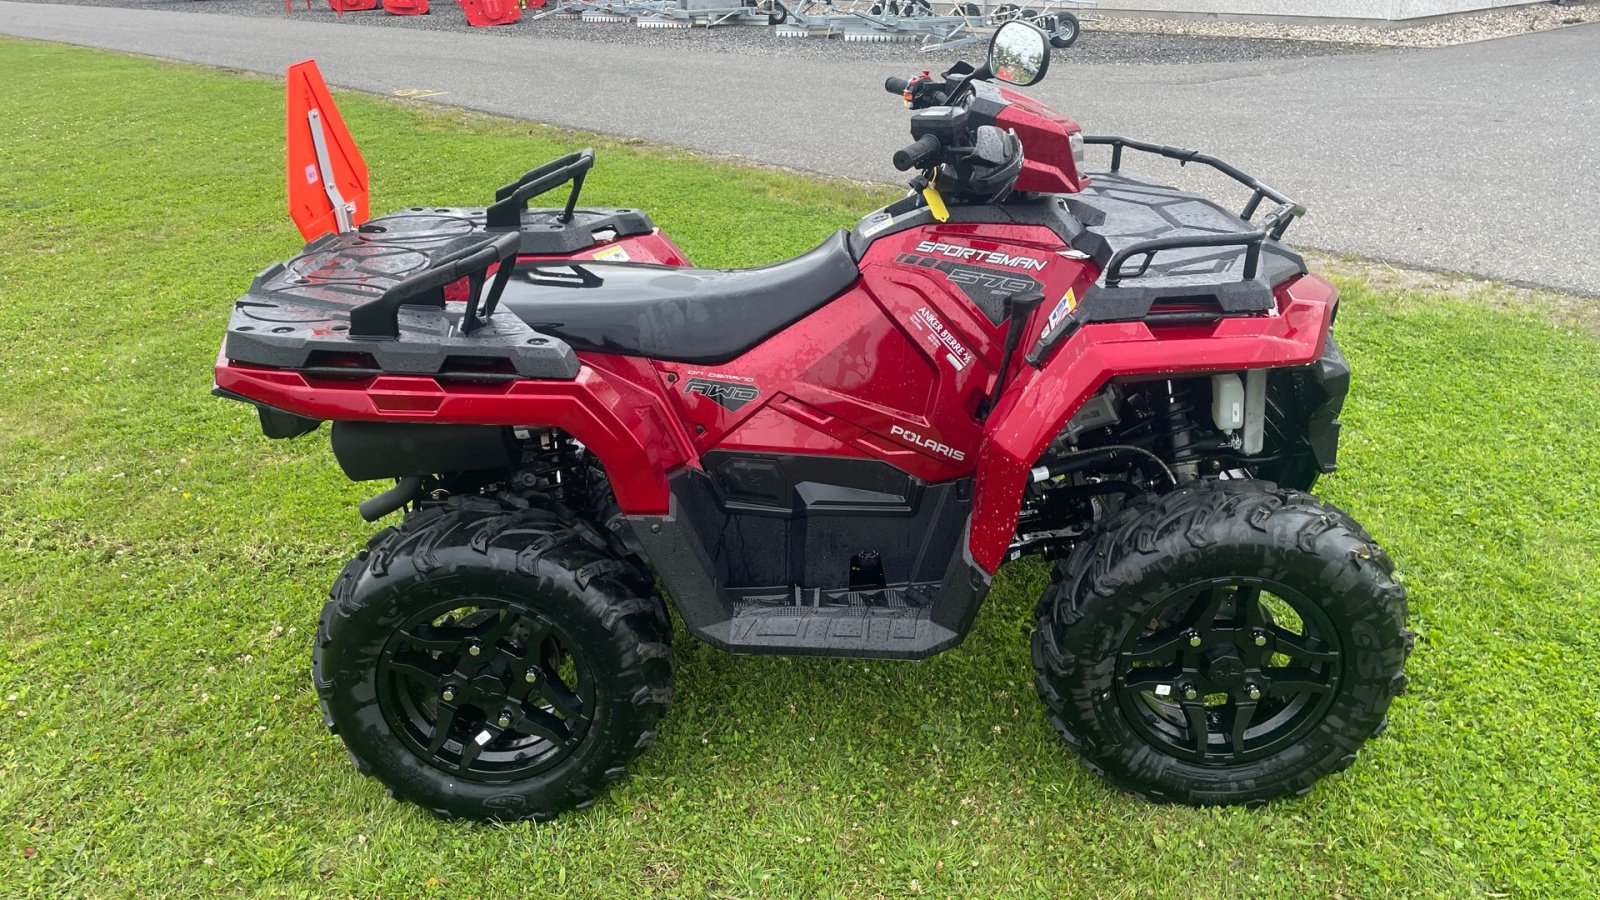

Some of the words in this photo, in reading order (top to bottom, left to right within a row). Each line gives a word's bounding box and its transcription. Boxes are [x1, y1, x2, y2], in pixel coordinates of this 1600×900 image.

[915, 241, 1048, 272] SPORTSMAN
[946, 268, 1035, 293] 570
[918, 307, 943, 333] ANKER
[940, 329, 965, 356] BJERRE
[684, 381, 761, 402] AWD
[890, 425, 965, 462] POLARIS
